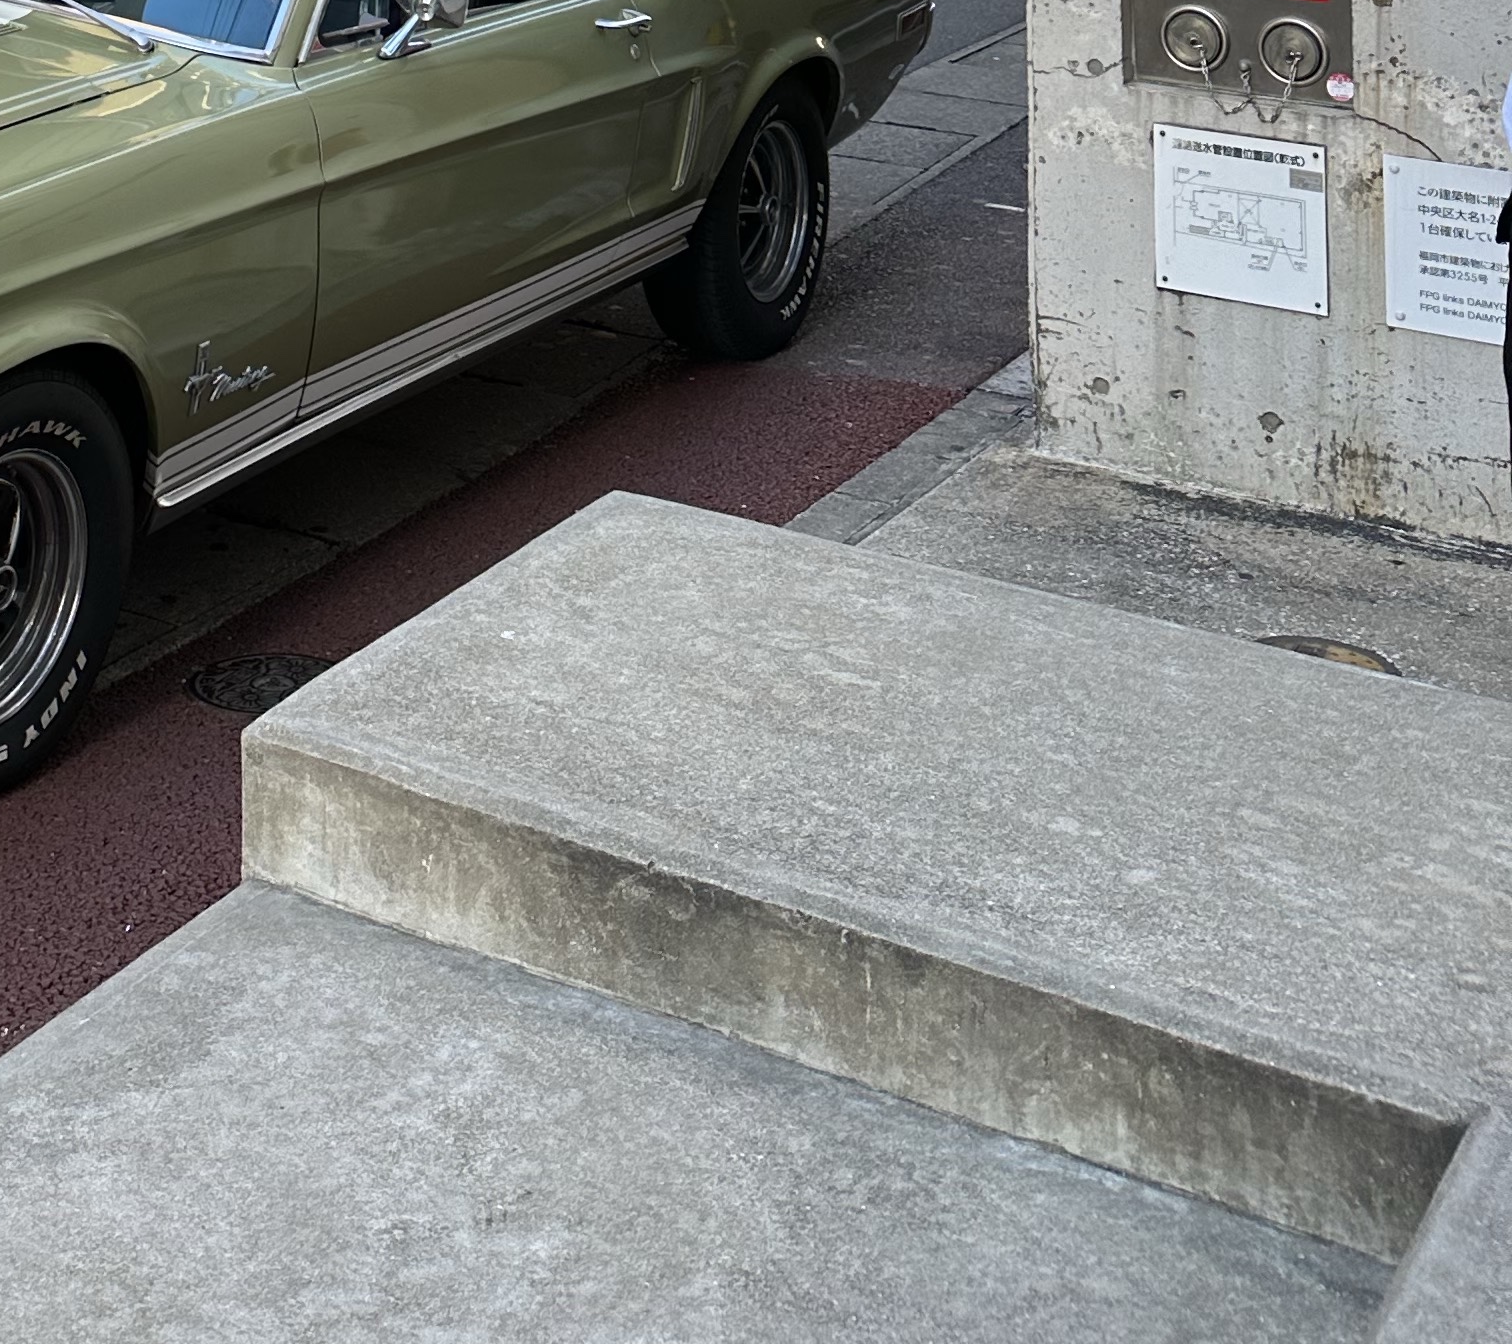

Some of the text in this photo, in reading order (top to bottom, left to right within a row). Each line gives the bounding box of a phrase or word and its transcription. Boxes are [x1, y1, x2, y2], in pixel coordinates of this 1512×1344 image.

[1419, 289, 1439, 301] FPG
[1419, 302, 1441, 314] FPG
[23, 649, 88, 749] INDY
